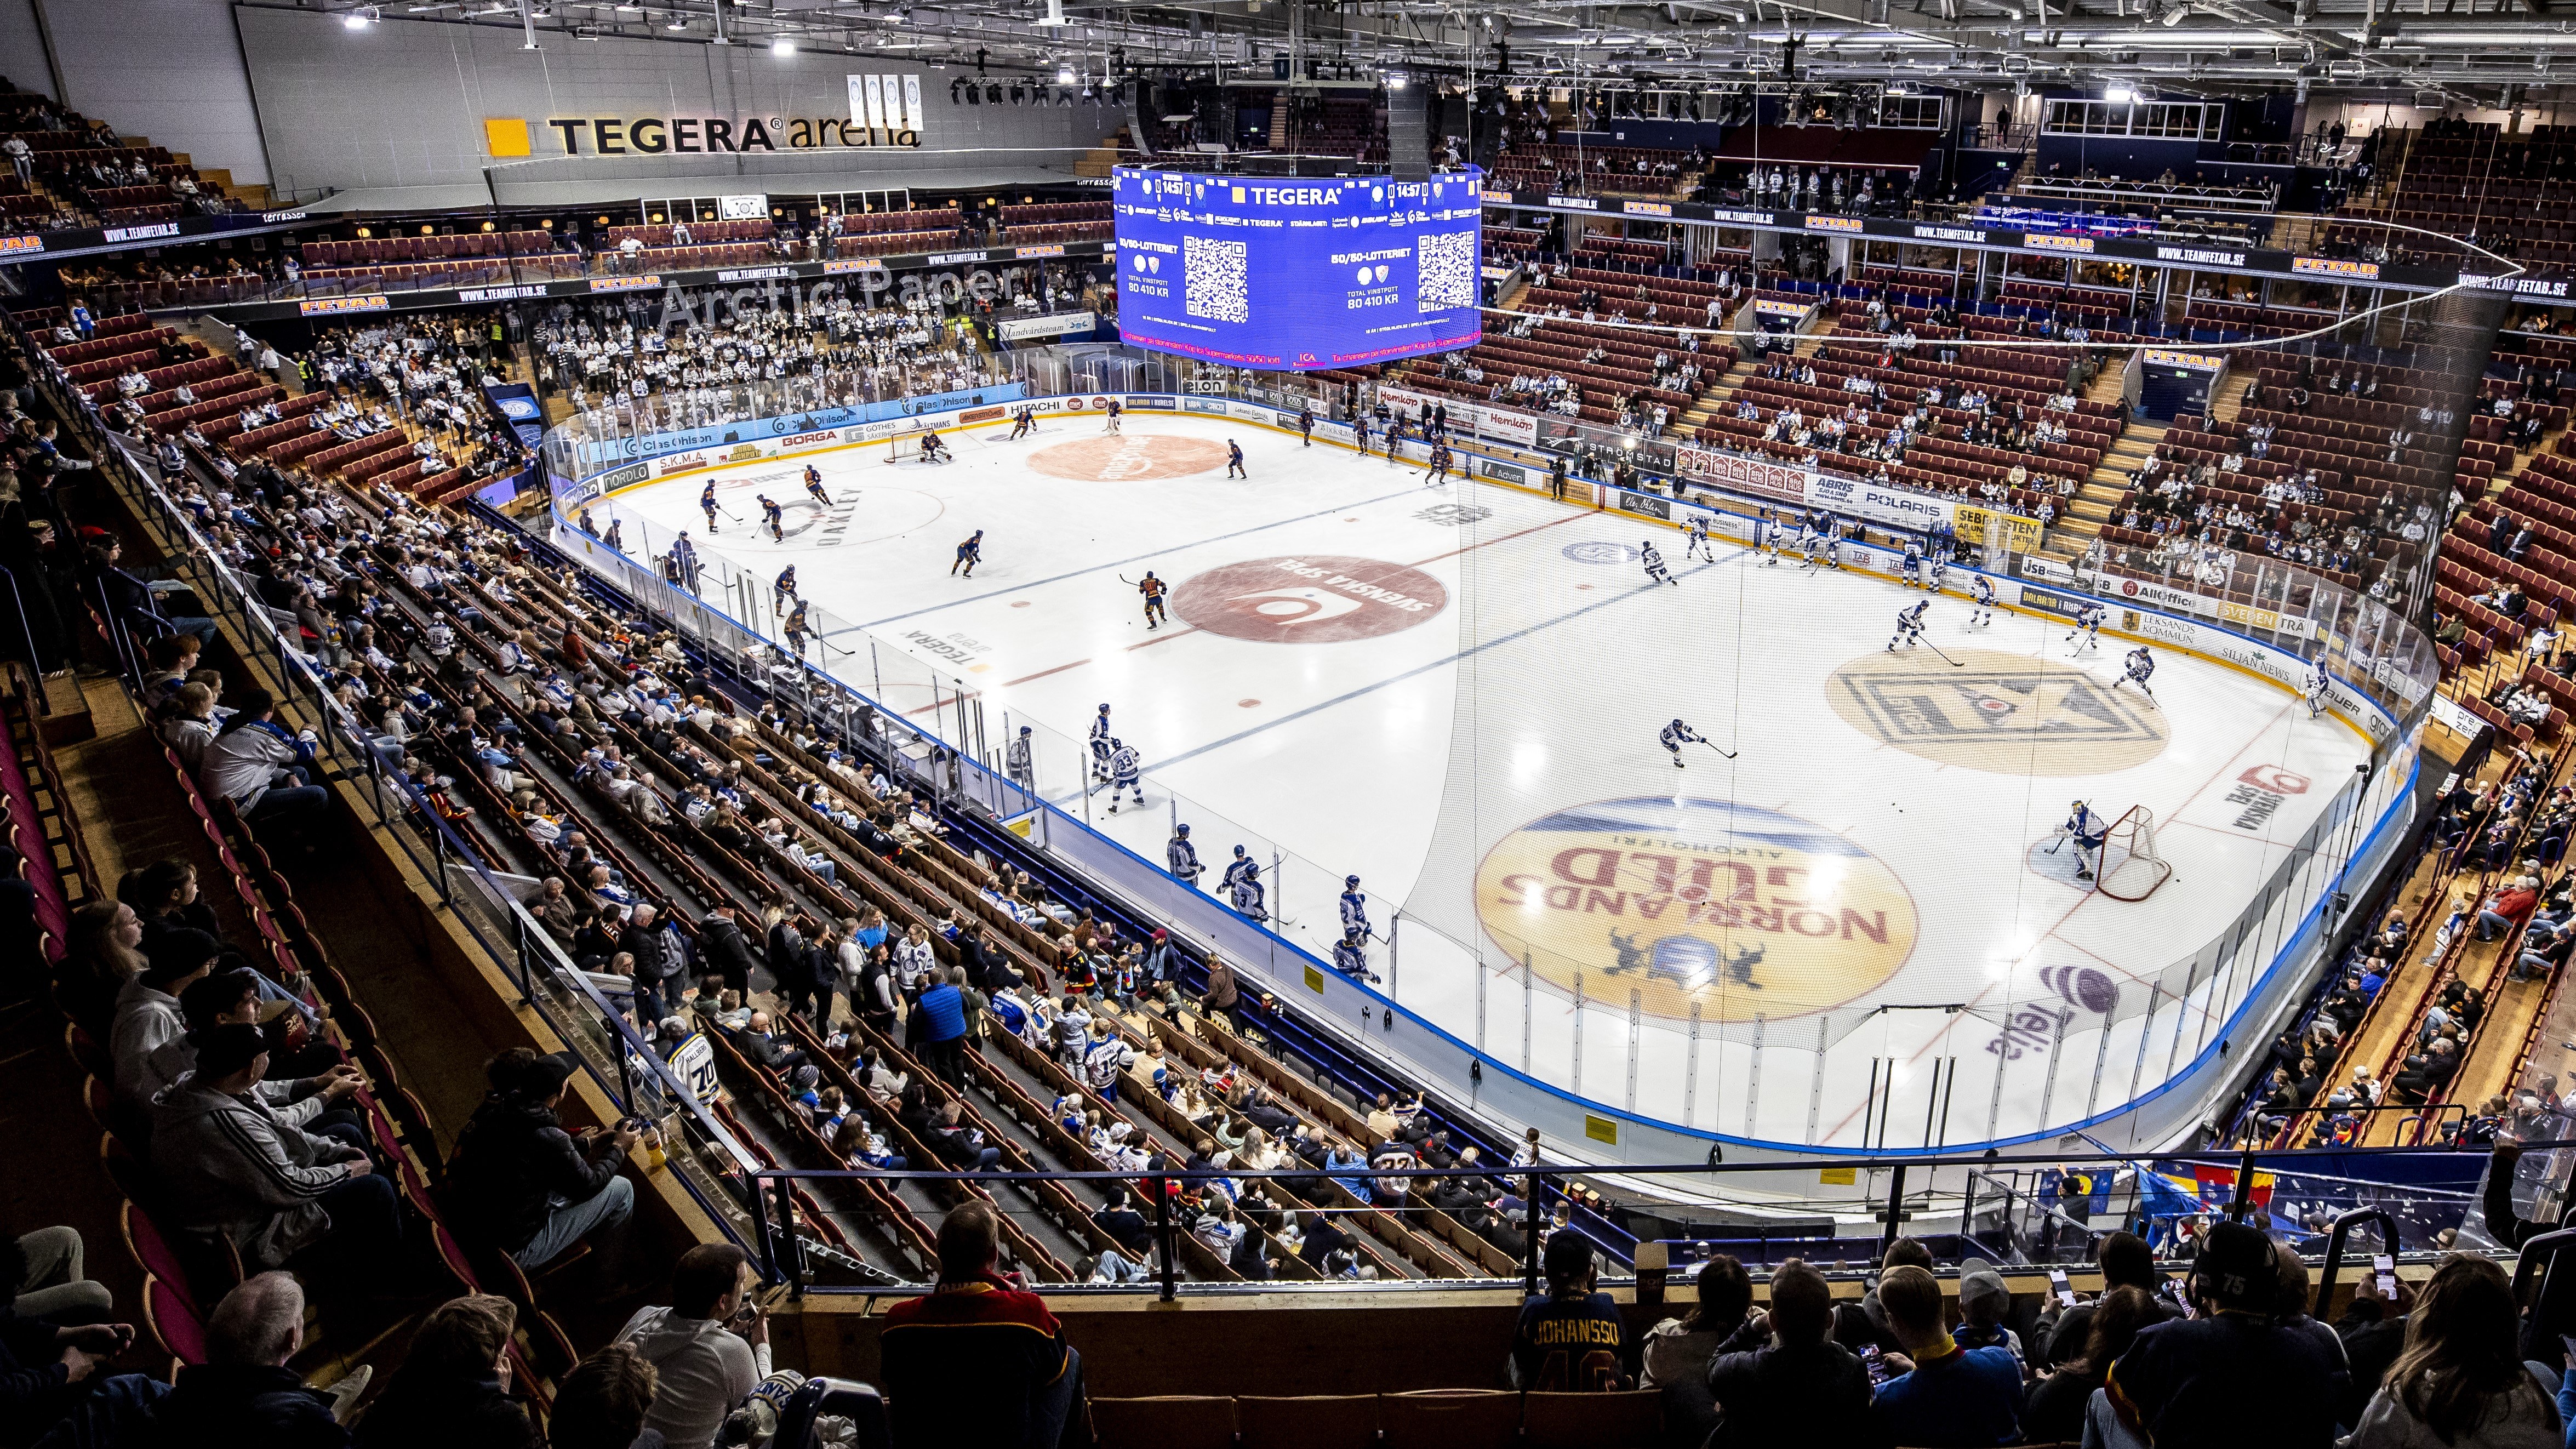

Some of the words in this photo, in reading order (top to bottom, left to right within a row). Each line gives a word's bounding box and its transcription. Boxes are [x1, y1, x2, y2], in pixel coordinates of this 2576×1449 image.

[790, 118, 921, 149] arena
[1162, 180, 1184, 195] 14:57
[1397, 184, 1421, 197] 14:57
[1547, 196, 1597, 210] WWW.TEAMFETAB.SE
[1625, 201, 1671, 213] FETAB
[1714, 210, 1774, 224] WWW.TEAMFETAB.SE
[1806, 216, 1863, 228] FETAB
[104, 223, 180, 242] WWW.TEAMFETAB.SE
[1914, 226, 1986, 242] WWW.TEAMFETAB.SE
[2025, 235, 2094, 248] FETAB
[1016, 246, 1064, 255] FETAB
[1330, 248, 1412, 265] 50/50-LOTTERIET
[2157, 247, 2246, 266] WWW.TEAMFETAB.SE
[824, 260, 881, 272] FETAB
[928, 252, 987, 265] WWW.TEAMFETAB.SE
[718, 267, 789, 281] WWW.TEAMFETAB.SE
[2293, 258, 2379, 275] FETAB
[591, 276, 660, 288] FETAB
[1128, 275, 1141, 283] TOTAL
[1142, 276, 1169, 286] VINSTPOTT
[659, 271, 834, 329] Arctic
[859, 265, 1024, 320] Paper
[1128, 282, 1139, 292] 80
[1140, 283, 1156, 295] 410
[1157, 286, 1169, 298] KR
[1347, 289, 1366, 297] TOTAL
[1367, 286, 1398, 295] VINSTPOTT
[301, 297, 387, 311] FETAB
[1347, 299, 1362, 309] 80
[1364, 296, 1383, 307] 410
[1384, 294, 1398, 305] KR
[1756, 300, 1810, 315] FETAB
[1004, 323, 1064, 338] Tandvårdsteam
[1299, 353, 1316, 361] ICA
[2144, 349, 2223, 369] FETAB
[1128, 400, 1150, 408] DALARNA
[1154, 398, 1174, 408] RÖRELSE
[1380, 390, 1419, 408] Hemköp
[962, 409, 1002, 422] ÅKERSTRÖMS
[1010, 402, 1060, 414] HITACHI
[1235, 406, 1251, 415] Leksands
[866, 422, 896, 432] GÖTHES
[1490, 413, 1533, 430] Hemköp
[643, 439, 670, 450] Clas
[782, 431, 837, 447] BORGA
[1418, 445, 1433, 453] Leksan
[1589, 442, 1671, 467] STRÖMSTAD
[660, 452, 707, 469] S.K.M.A.
[1497, 469, 1523, 483] Adven
[1817, 478, 1855, 493] ABRIS
[1633, 507, 1655, 516] FOUNDATION
[1866, 493, 1940, 517] POLARIS
[816, 488, 862, 546] OAKLEY
[1712, 518, 1738, 529] BUSINESS
[1325, 574, 1434, 613] SVENSKA
[2139, 585, 2195, 607] AllOffice
[2144, 614, 2196, 635] LEKSANDS
[2281, 619, 2305, 632] TRÄ
[2143, 625, 2193, 643] KOMMUN
[946, 632, 992, 653] arena
[2222, 647, 2258, 668] SILJAN
[2260, 662, 2291, 682] NEWS
[1117, 755, 1133, 771] 33
[1239, 893, 1248, 908] 3
[1499, 874, 1889, 944] NORRLANDS
[1102, 1053, 1119, 1077] 15
[690, 1058, 715, 1093] 70
[2223, 1273, 2246, 1295] 75
[1534, 1318, 1621, 1347] JOHANSSO
